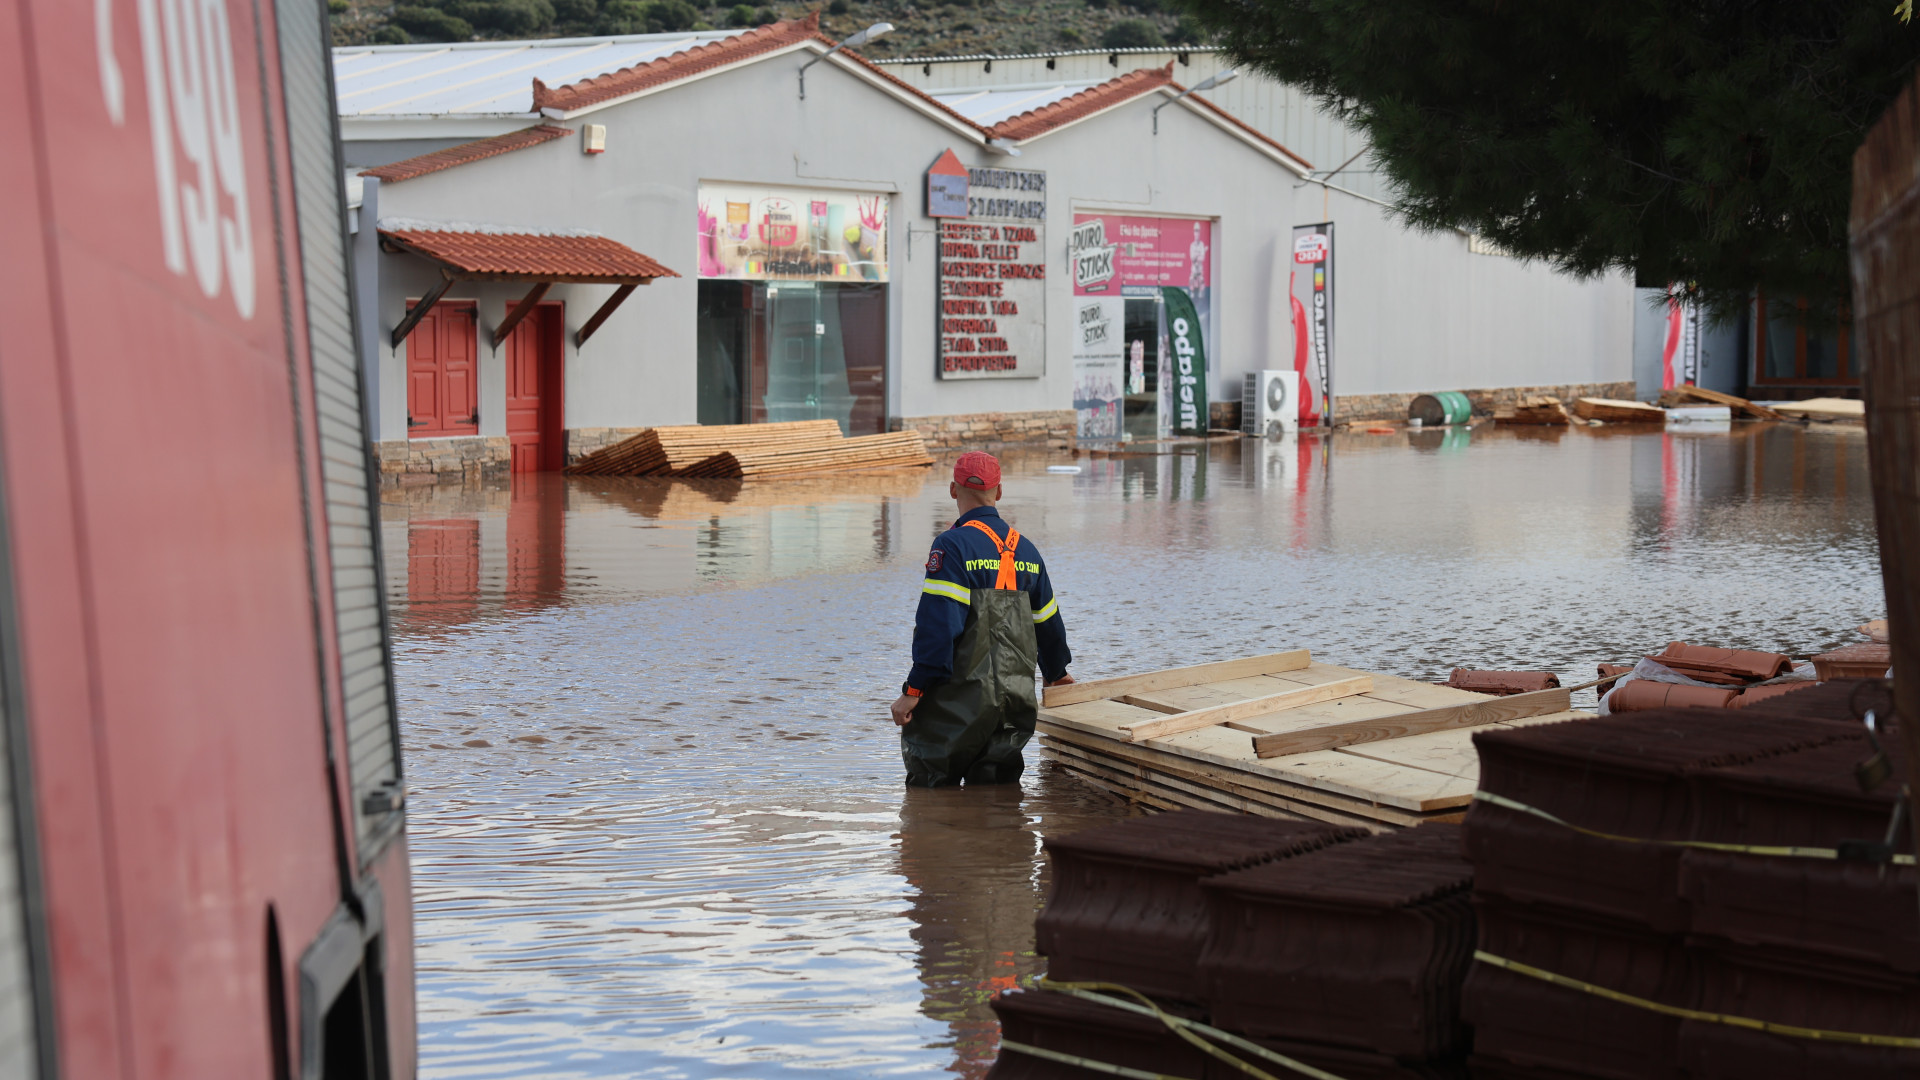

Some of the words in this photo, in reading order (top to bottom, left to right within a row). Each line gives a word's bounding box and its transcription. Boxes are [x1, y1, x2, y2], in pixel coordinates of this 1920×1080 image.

[1073, 224, 1102, 253] DURO
[982, 244, 1020, 260] PELLET
[1079, 250, 1111, 280] STICK
[1080, 306, 1100, 325] DURO
[1084, 323, 1107, 344] STICK
